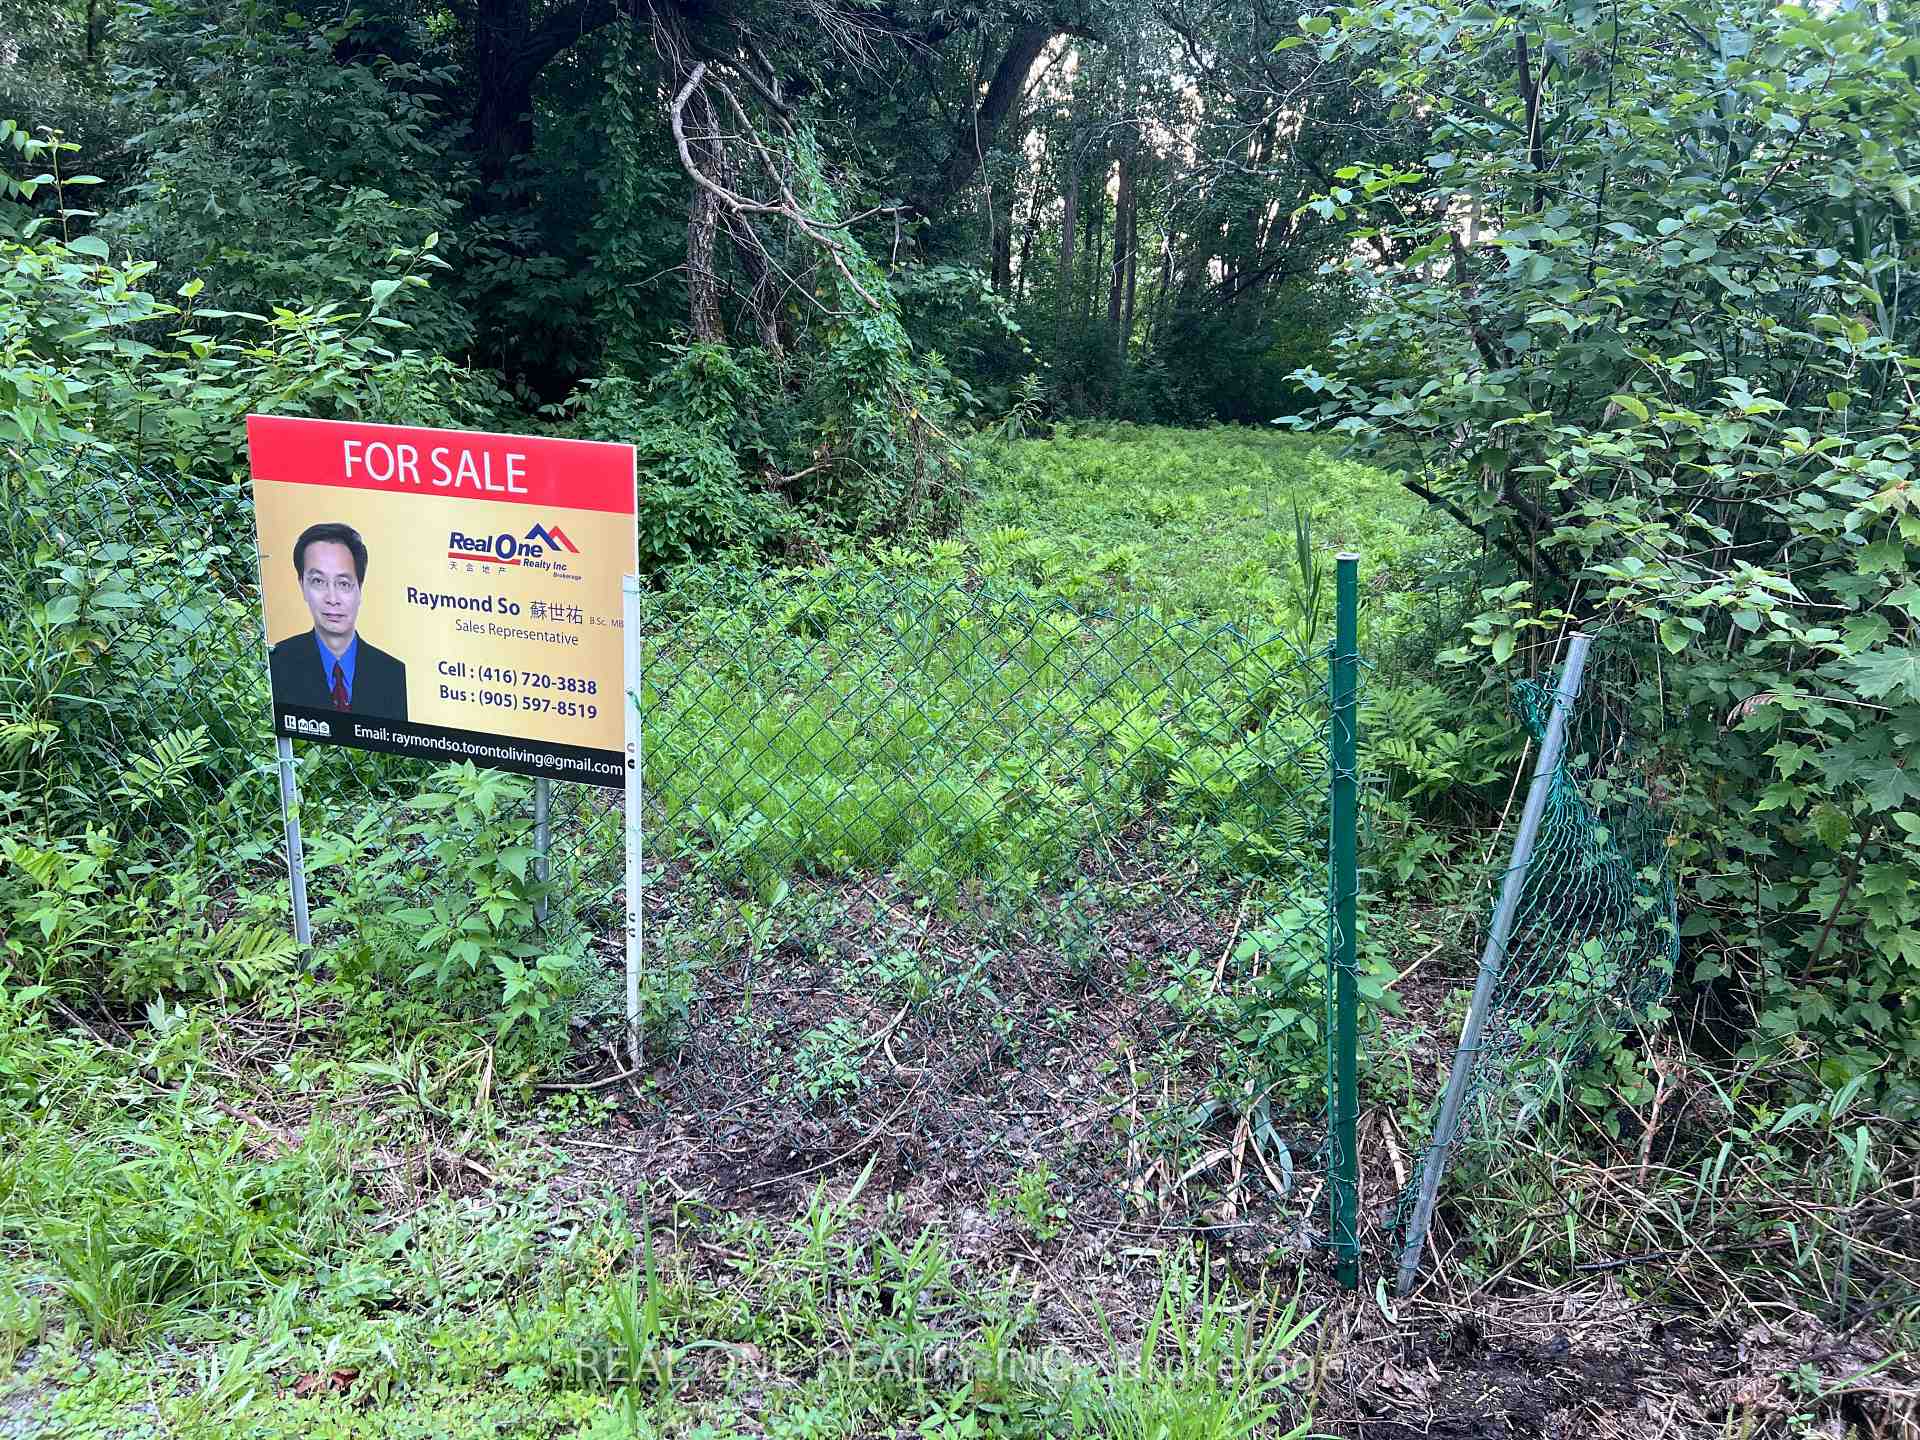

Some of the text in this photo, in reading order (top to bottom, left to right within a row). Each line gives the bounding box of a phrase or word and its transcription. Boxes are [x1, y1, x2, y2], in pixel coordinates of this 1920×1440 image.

[343, 439, 529, 494] FOR SALE
[449, 531, 544, 560] Real One
[522, 558, 567, 572] Realty Inc
[553, 571, 582, 581] Brokerage
[407, 586, 493, 613] Raymond
[497, 597, 521, 616] So
[455, 618, 579, 647] Sales Representative
[438, 661, 466, 677] Cell
[478, 665, 517, 687] (416)
[521, 671, 598, 696] 720-3838
[439, 684, 467, 702] Bus
[479, 689, 518, 711] (905)
[522, 696, 598, 719] 597-8519
[354, 724, 624, 777] Email: raymondso.torontoliving@gmail.com
